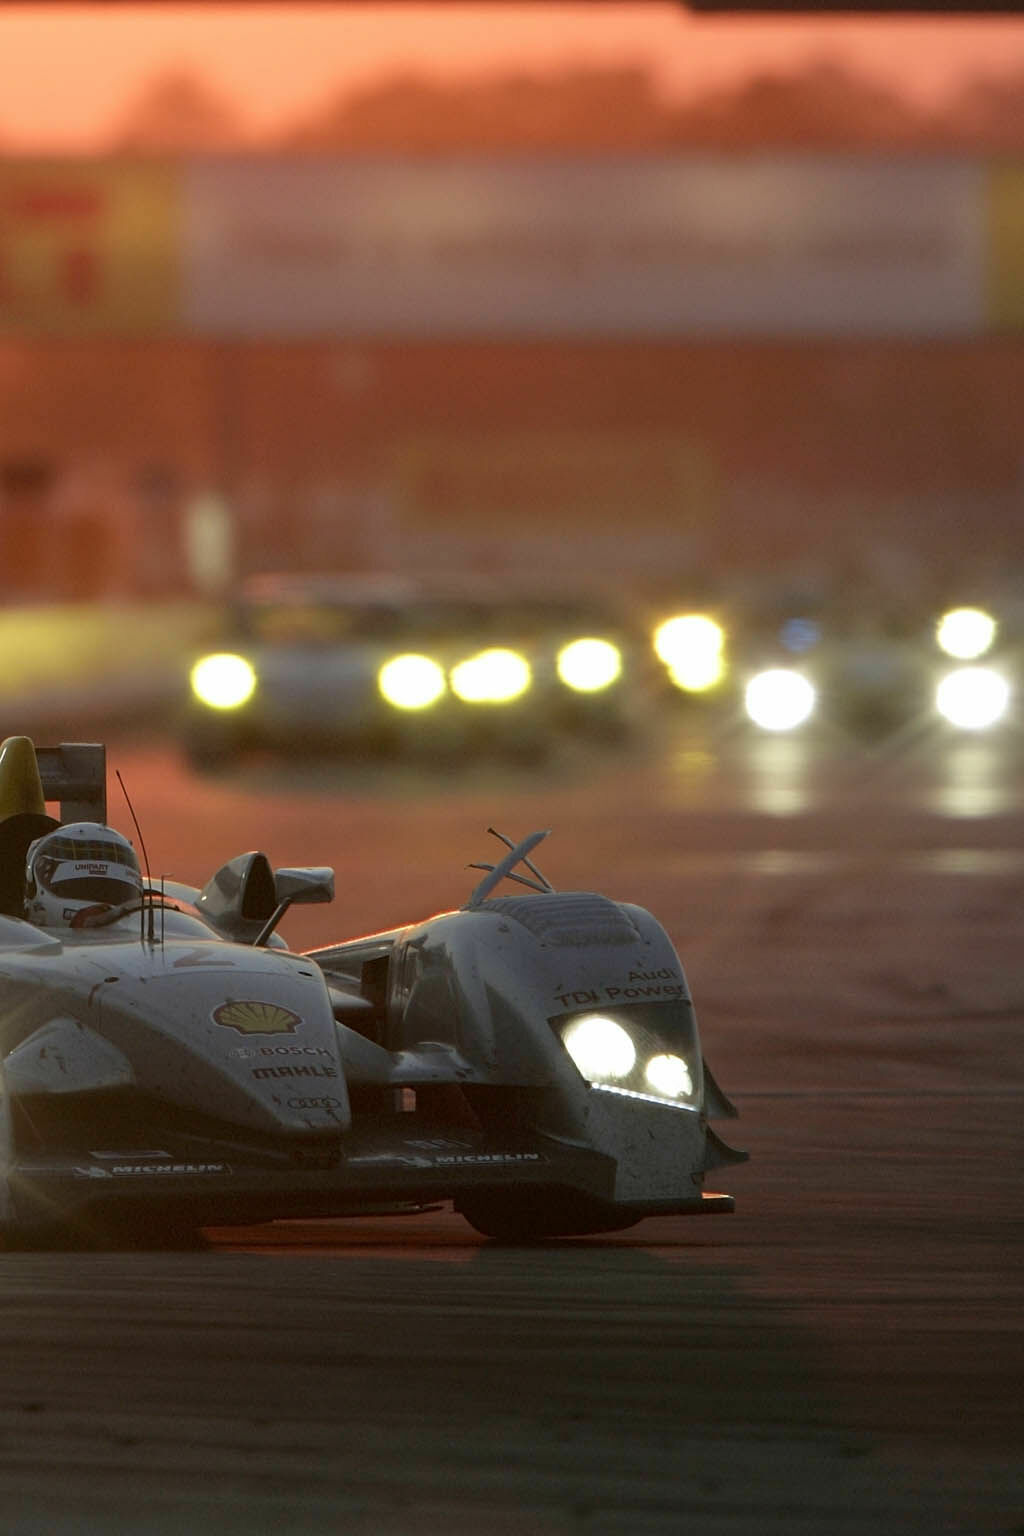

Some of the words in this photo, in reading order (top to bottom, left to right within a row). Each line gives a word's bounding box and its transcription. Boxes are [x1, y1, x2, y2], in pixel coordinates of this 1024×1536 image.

[628, 968, 677, 983] Audi
[553, 987, 599, 1007] TDI
[606, 984, 685, 1002] Power
[259, 1047, 335, 1061] BOSCH
[251, 1063, 337, 1080] MAHLE
[435, 1152, 539, 1163] MICHELIN
[111, 1164, 225, 1174] MICHELIN
